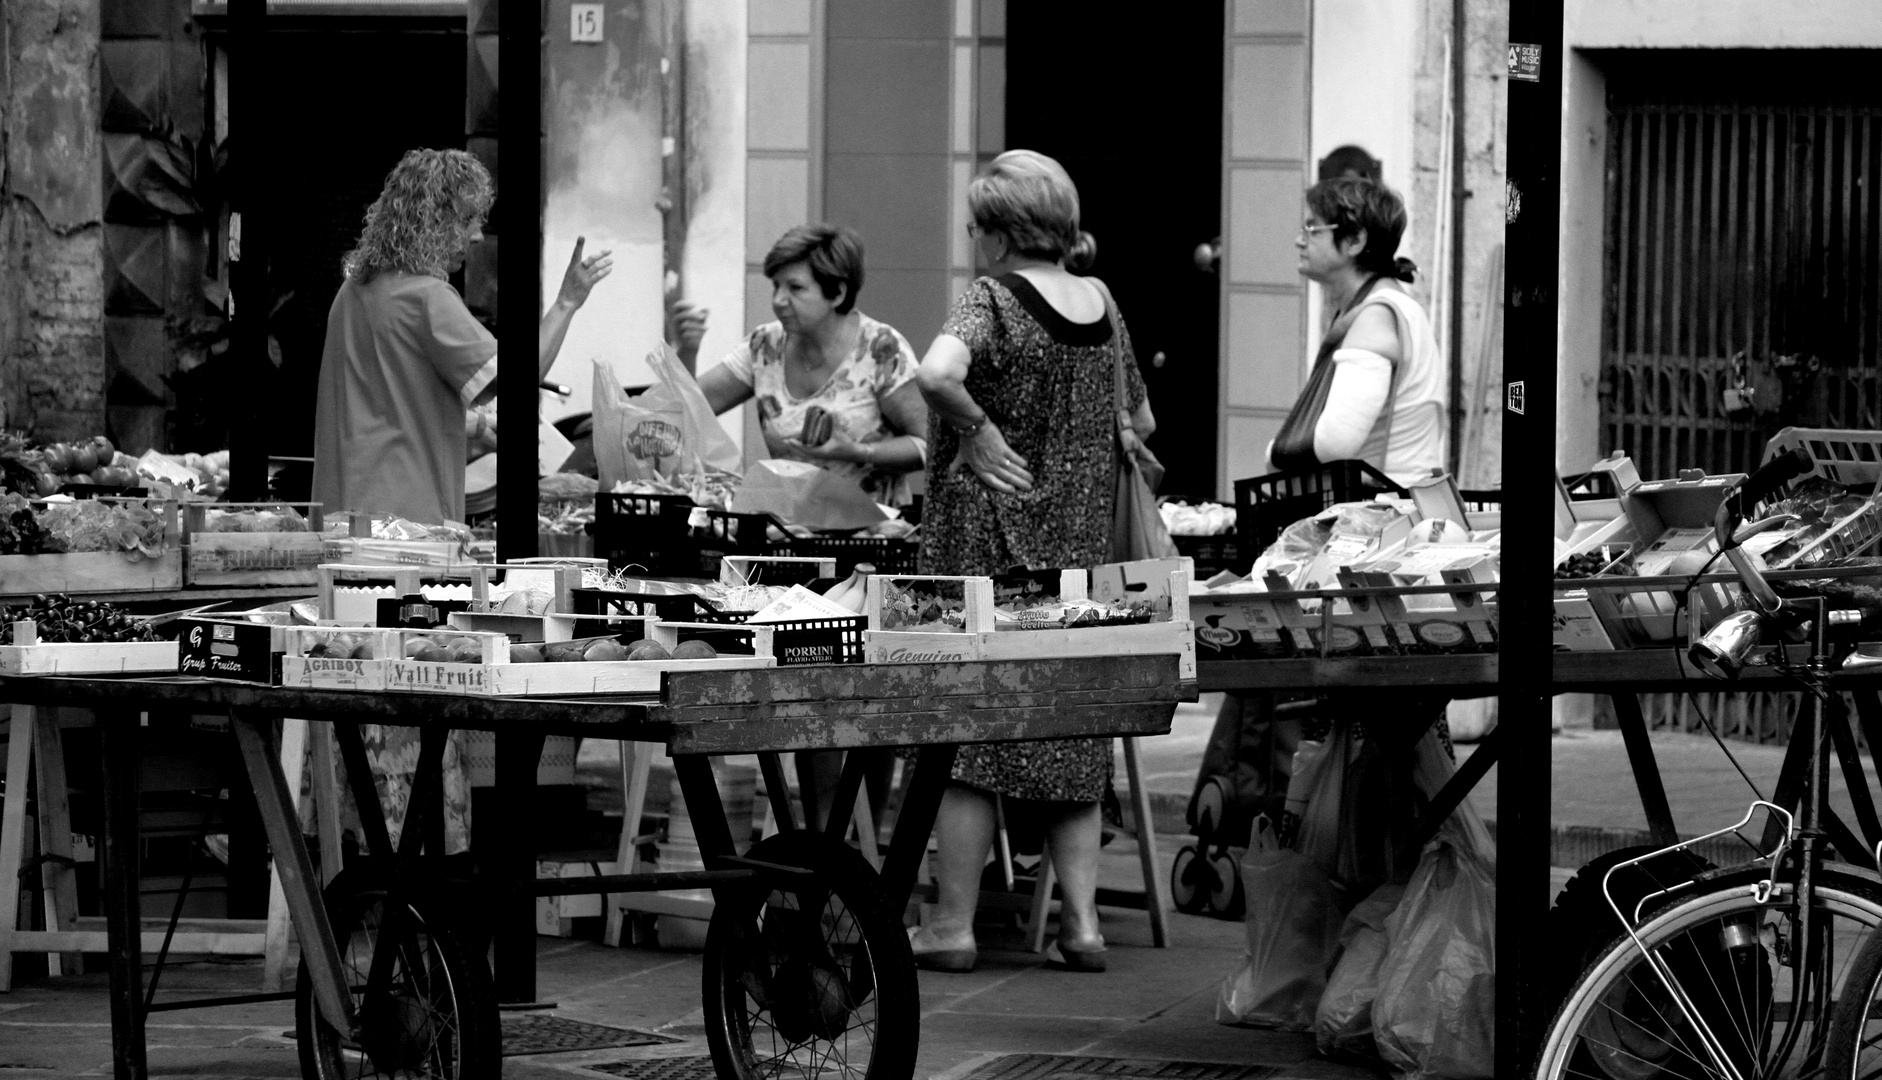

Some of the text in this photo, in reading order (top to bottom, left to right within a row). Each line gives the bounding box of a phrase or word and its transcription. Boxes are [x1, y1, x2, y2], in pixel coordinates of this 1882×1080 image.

[578, 11, 597, 36] 15
[1521, 55, 1540, 65] MUSIC
[1510, 385, 1523, 397] BER
[222, 549, 295, 567] RIMINI
[1017, 609, 1050, 621] Frutta
[784, 645, 834, 657] PORRINI
[889, 647, 962, 663] Genuino
[182, 654, 206, 672] Grup
[303, 660, 364, 676] AGRIBOX
[395, 664, 483, 686] Vall Fruit
